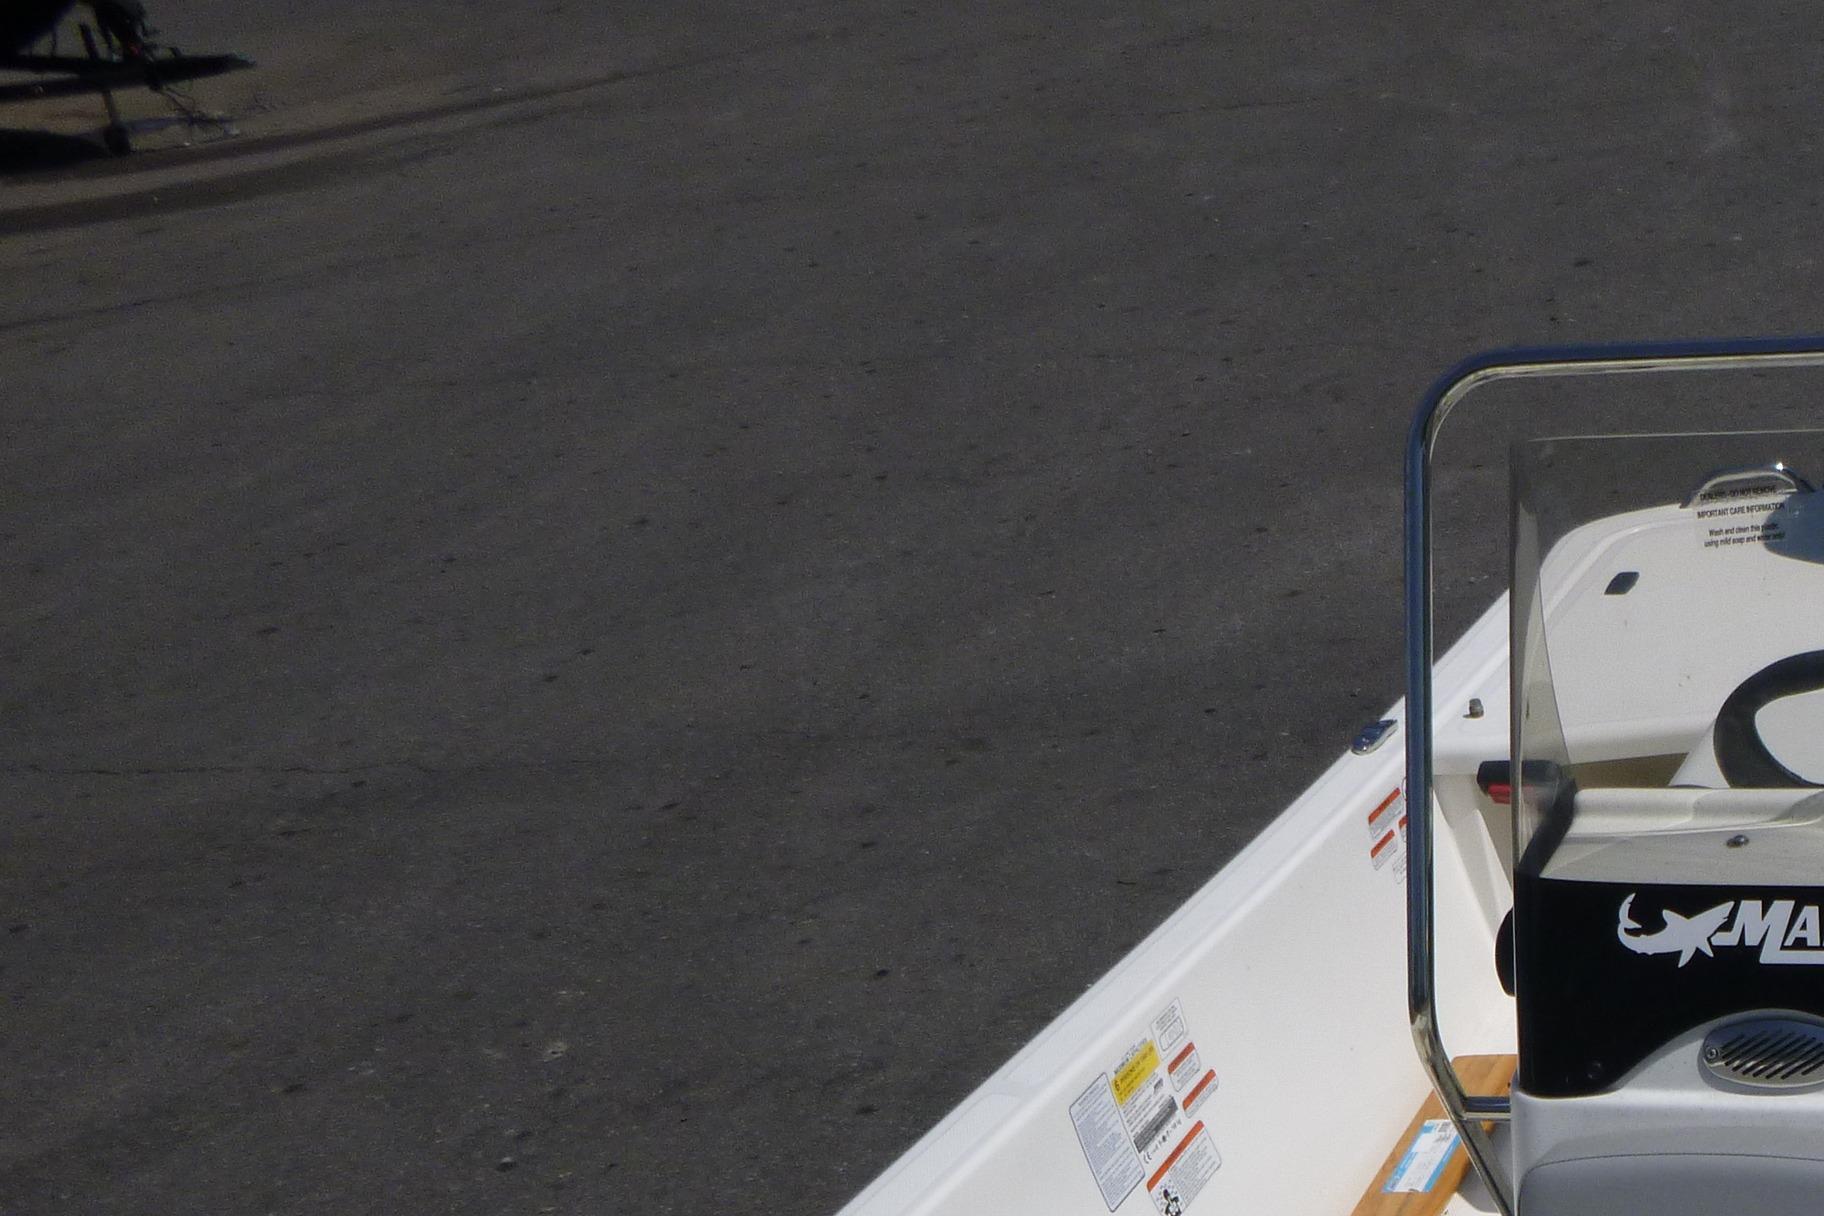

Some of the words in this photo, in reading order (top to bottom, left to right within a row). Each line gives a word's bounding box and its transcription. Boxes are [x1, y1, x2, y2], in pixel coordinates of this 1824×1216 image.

[1740, 487, 1751, 496] NOT
[1697, 507, 1729, 519] IMPORTANT
[1730, 505, 1746, 515] CARE
[1746, 502, 1786, 513] INFORMATION
[1746, 534, 1756, 542] and
